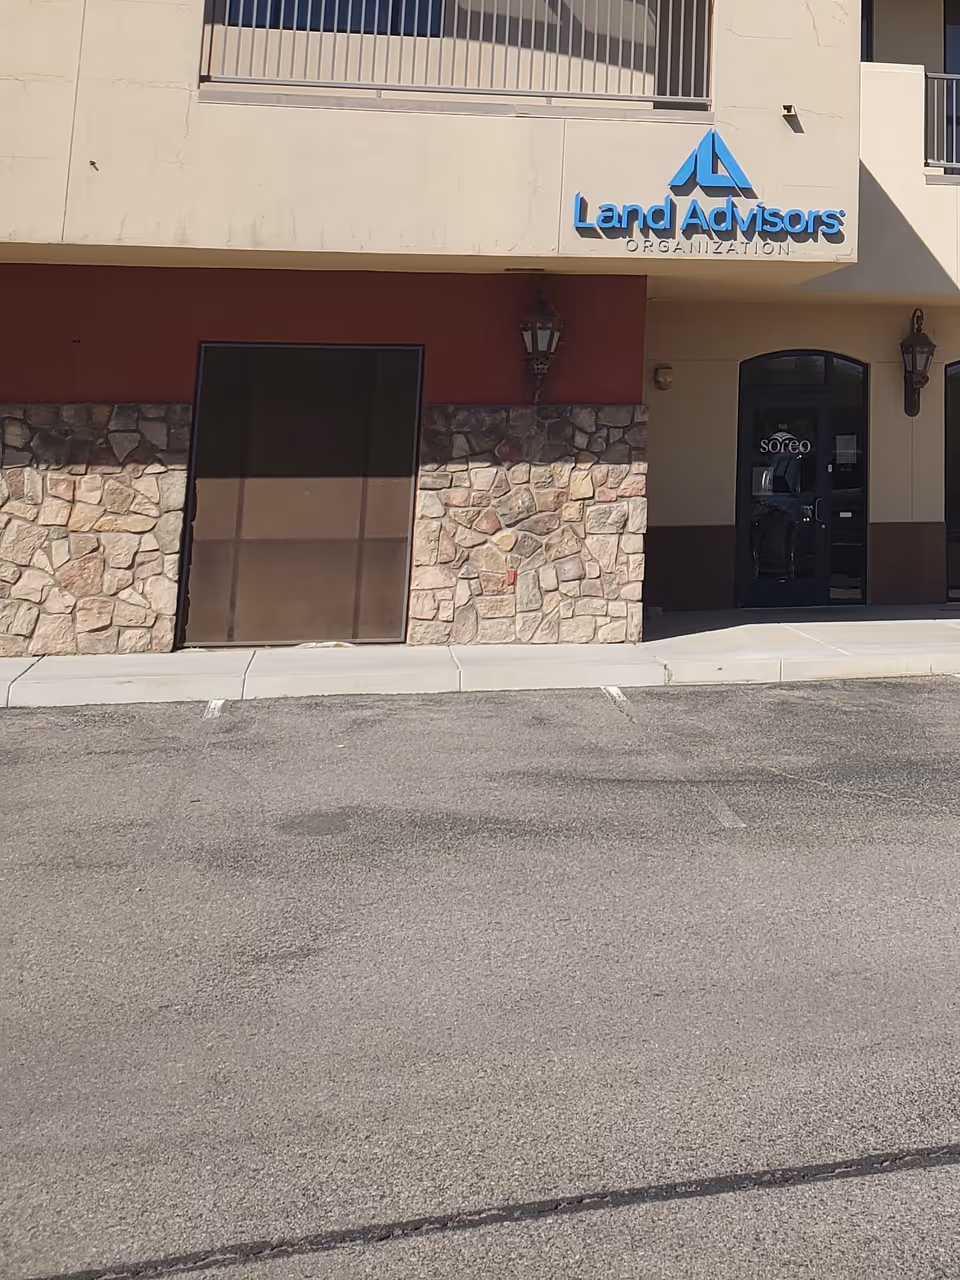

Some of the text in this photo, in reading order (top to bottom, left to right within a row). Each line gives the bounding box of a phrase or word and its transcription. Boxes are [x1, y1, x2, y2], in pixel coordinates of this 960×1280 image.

[573, 191, 843, 234] Land Advisors
[625, 238, 792, 256] ORGANIZATION
[760, 439, 811, 453] soreo
